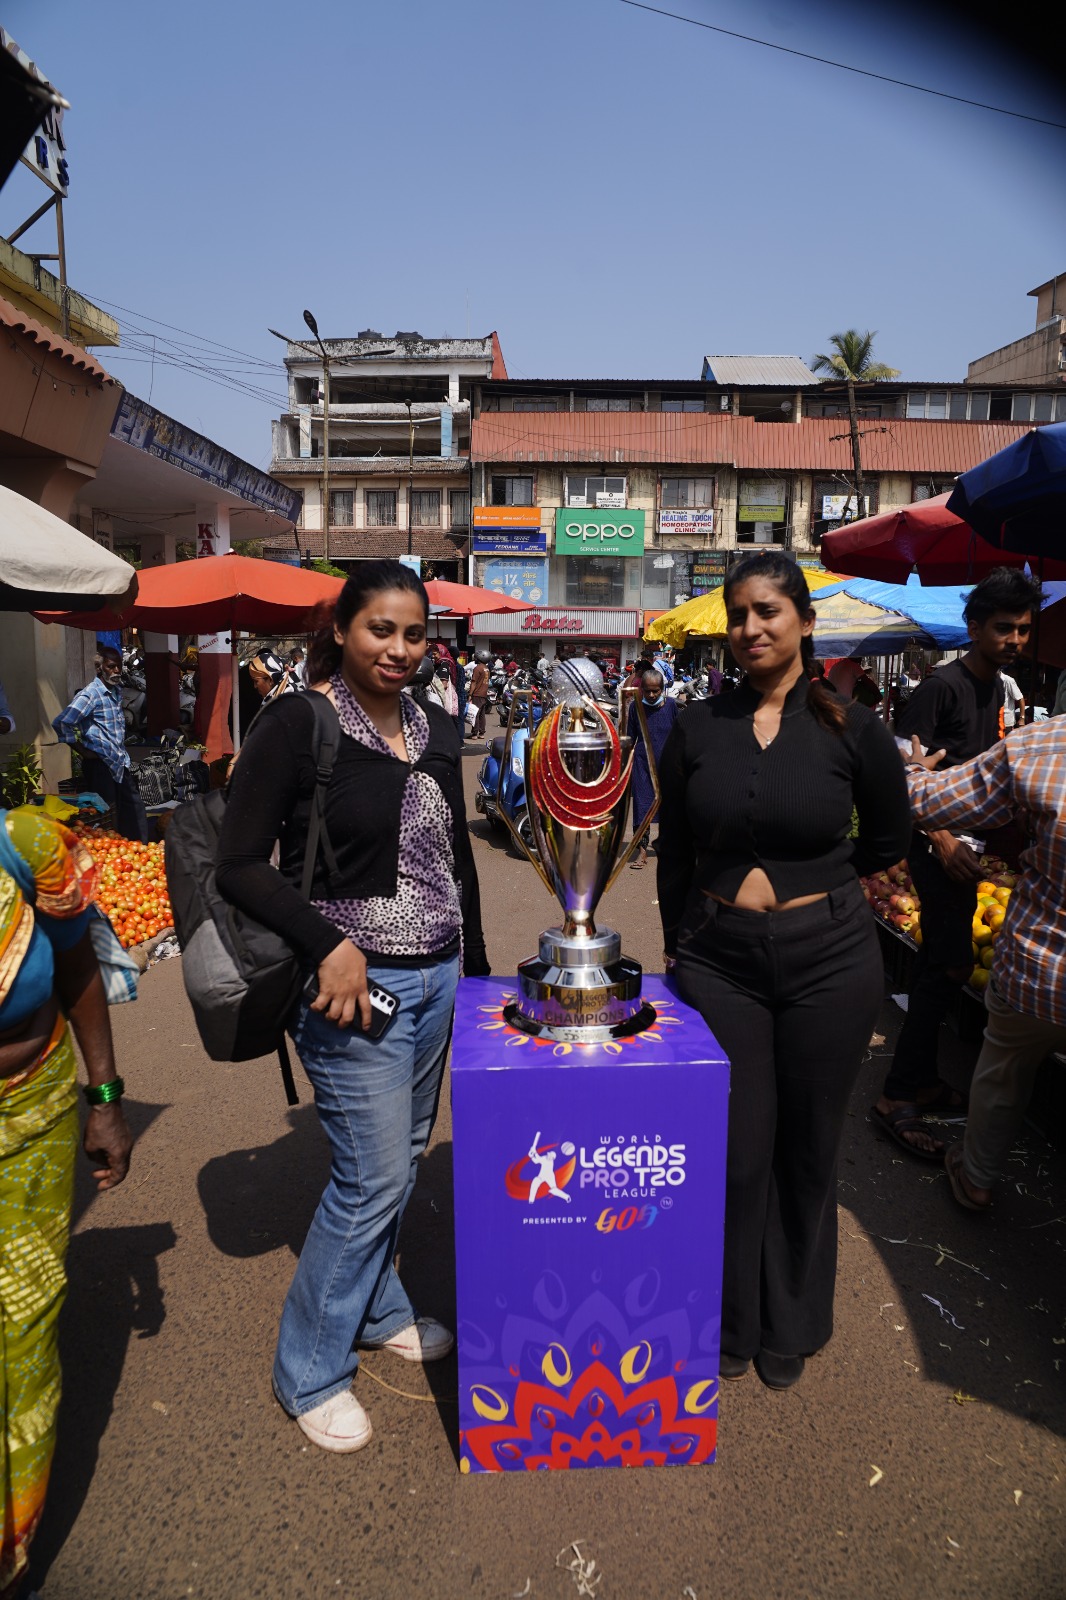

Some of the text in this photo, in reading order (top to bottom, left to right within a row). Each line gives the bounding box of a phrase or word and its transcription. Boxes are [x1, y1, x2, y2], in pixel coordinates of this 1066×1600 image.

[565, 523, 635, 541] oppo
[504, 574, 518, 586] 1%
[521, 613, 584, 630] Bata
[544, 1008, 625, 1025] CHAMPIONS
[600, 1134, 662, 1144] WORLD
[579, 1144, 686, 1168] LEGENDS
[579, 1166, 686, 1189] PRO T20
[604, 1188, 657, 1199] LEAGUE
[523, 1216, 587, 1225] PRESENTED BY
